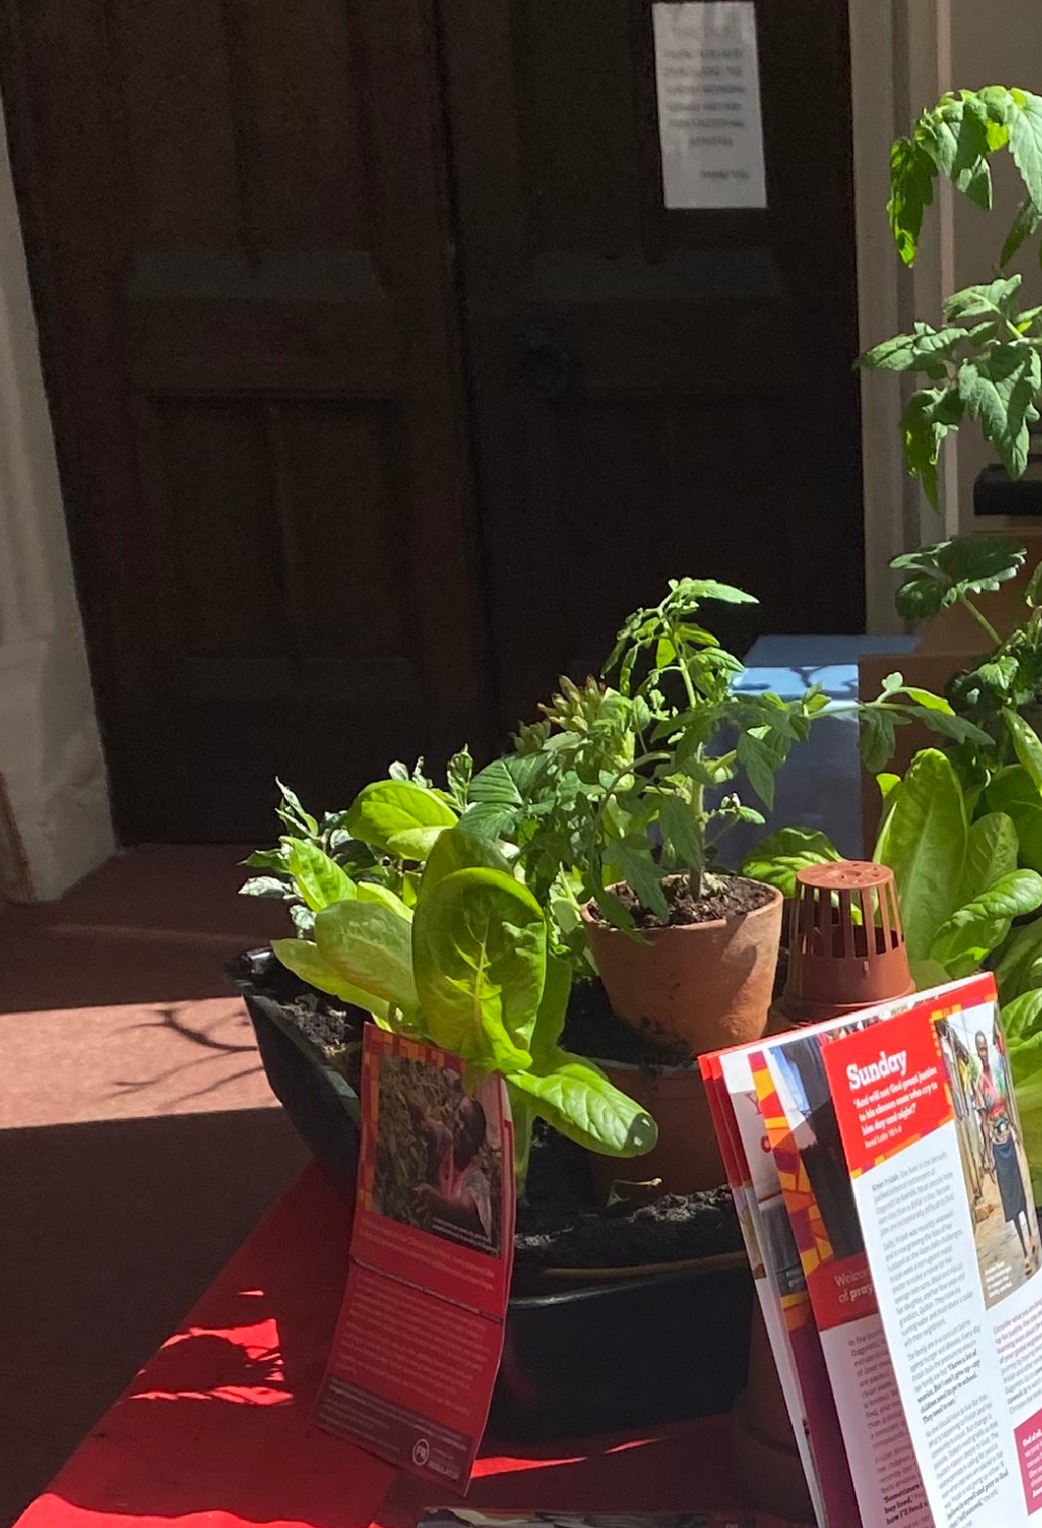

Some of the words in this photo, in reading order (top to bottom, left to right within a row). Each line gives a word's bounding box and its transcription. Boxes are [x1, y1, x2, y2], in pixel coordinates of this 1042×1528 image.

[846, 1051, 906, 1091] Sunday
[890, 1080, 902, 1093] God
[859, 1113, 866, 1122] to
[866, 1108, 876, 1119] his
[909, 1089, 922, 1100] who
[922, 1086, 932, 1094] cry
[931, 1082, 938, 1091] to
[861, 1124, 875, 1136] him
[875, 1119, 886, 1129] day
[886, 1112, 898, 1125] and
[839, 1288, 848, 1302] of
[849, 1284, 873, 1302] pray
